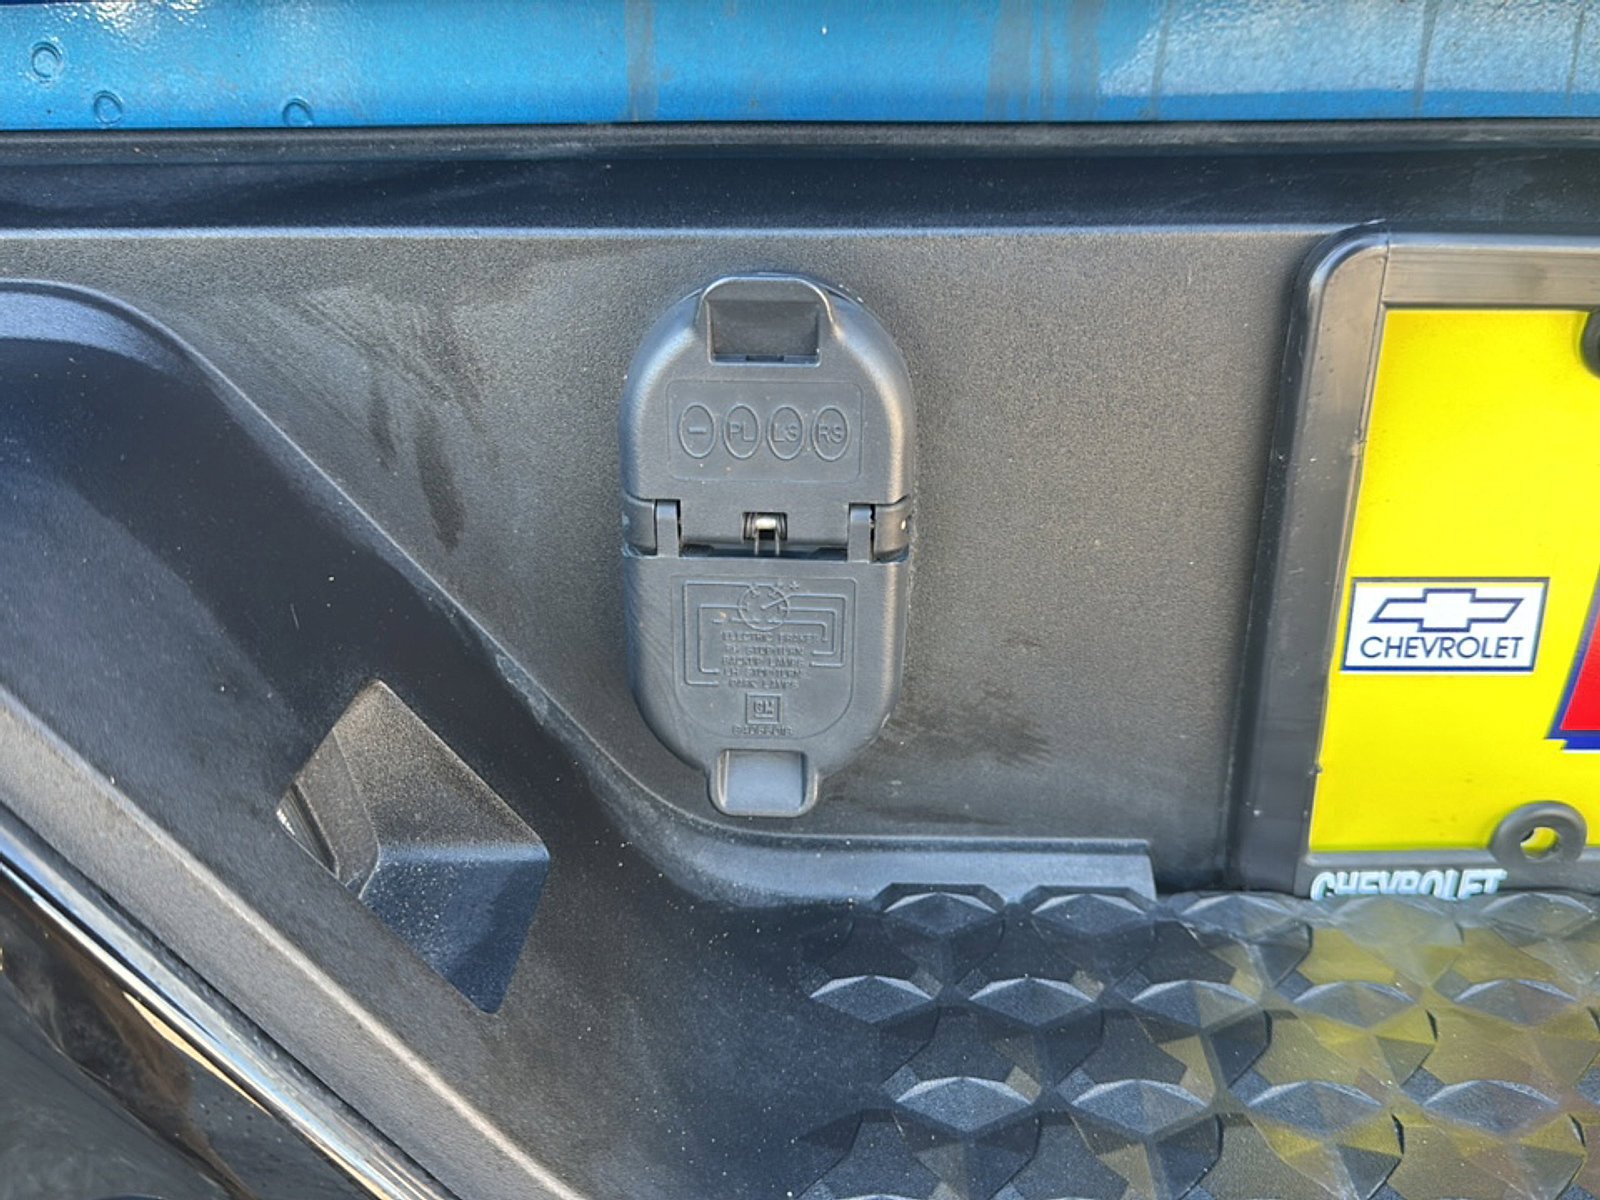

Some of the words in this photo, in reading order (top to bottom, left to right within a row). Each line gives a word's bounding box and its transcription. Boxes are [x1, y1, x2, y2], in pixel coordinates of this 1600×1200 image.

[728, 423, 756, 442] PL
[771, 424, 799, 443] LS
[816, 424, 843, 444] RS
[1360, 636, 1524, 659] CHEVROLET
[1310, 868, 1508, 901] CHEVROLET
